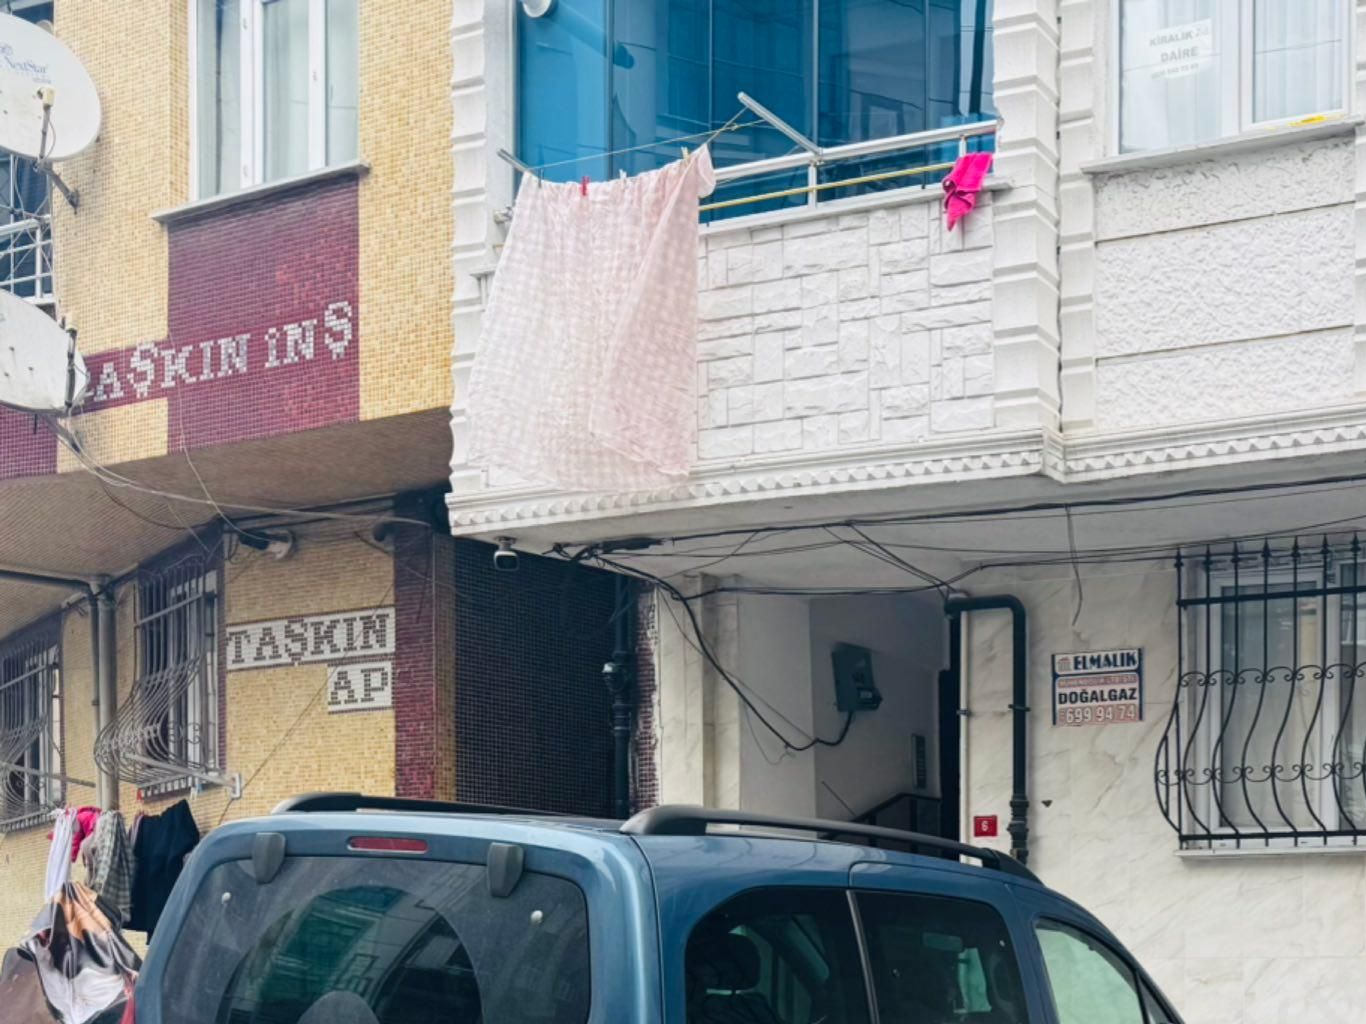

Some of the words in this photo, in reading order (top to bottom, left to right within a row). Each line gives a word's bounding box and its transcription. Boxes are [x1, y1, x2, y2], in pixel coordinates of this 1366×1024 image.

[84, 333, 251, 400] AŞKIN
[226, 613, 390, 664] TAŞKIN
[1073, 652, 1137, 671] ELMALIK
[328, 667, 389, 705] AP
[1058, 687, 1137, 705] DOĞALGAZ
[1066, 707, 1092, 723] 699
[1096, 706, 1113, 722] 94
[1118, 705, 1135, 719] 74
